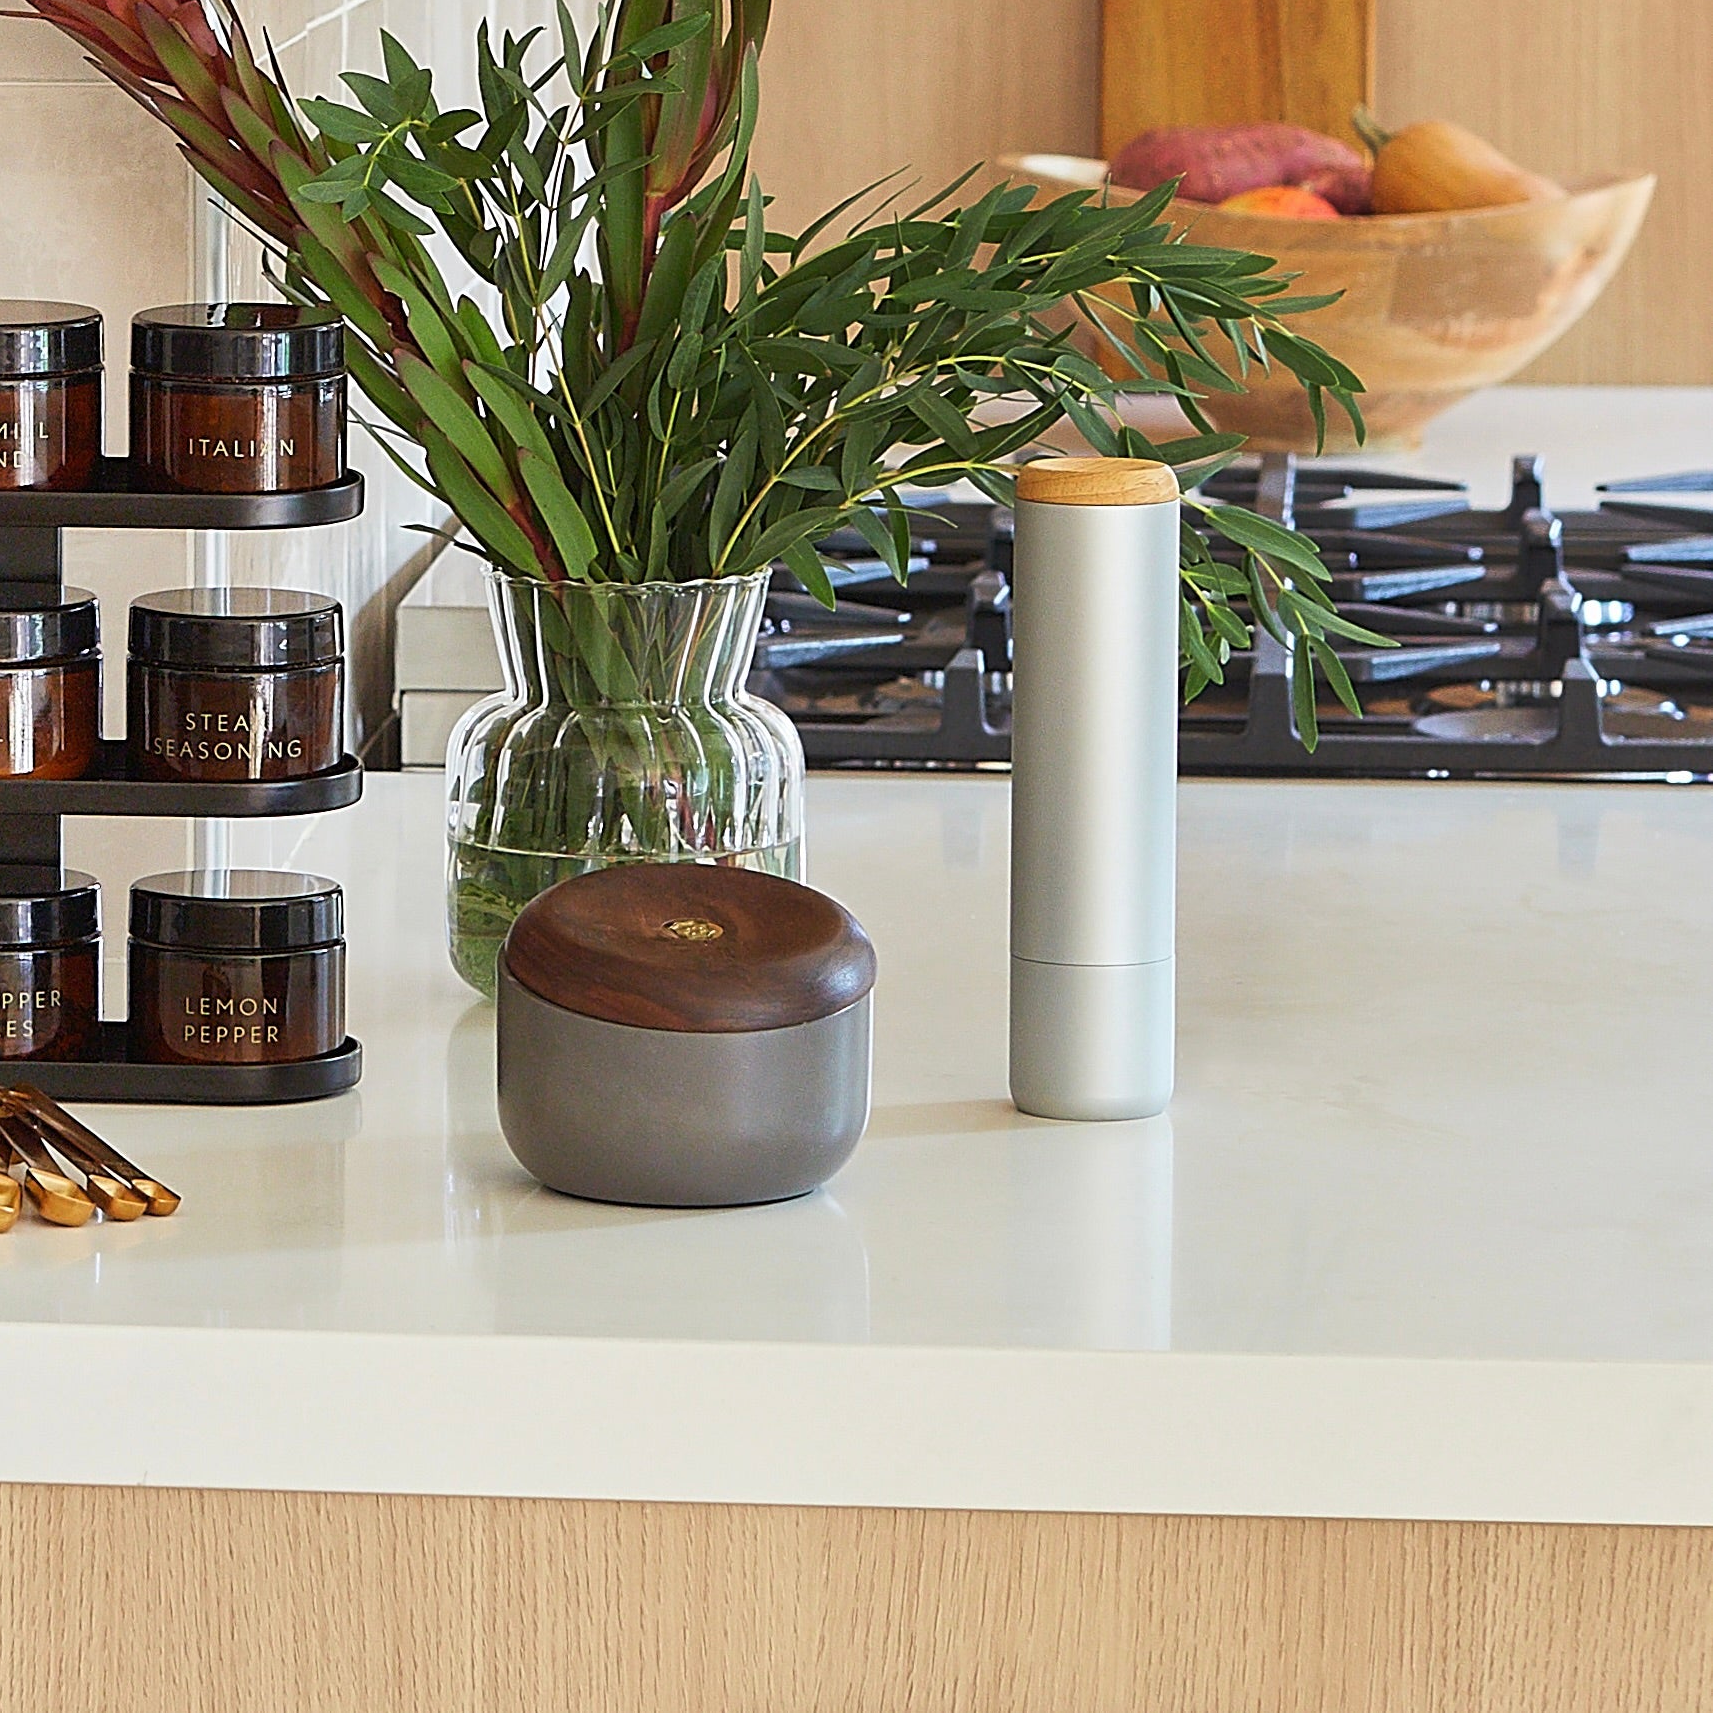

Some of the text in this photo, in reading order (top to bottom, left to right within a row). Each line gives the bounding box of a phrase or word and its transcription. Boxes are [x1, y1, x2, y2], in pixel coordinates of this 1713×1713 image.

[188, 437, 295, 458] ITALIAN
[185, 711, 257, 734] STEA
[153, 736, 304, 760] SEASONNG
[183, 994, 280, 1017] LEMON
[183, 1022, 280, 1046] PEPPER
